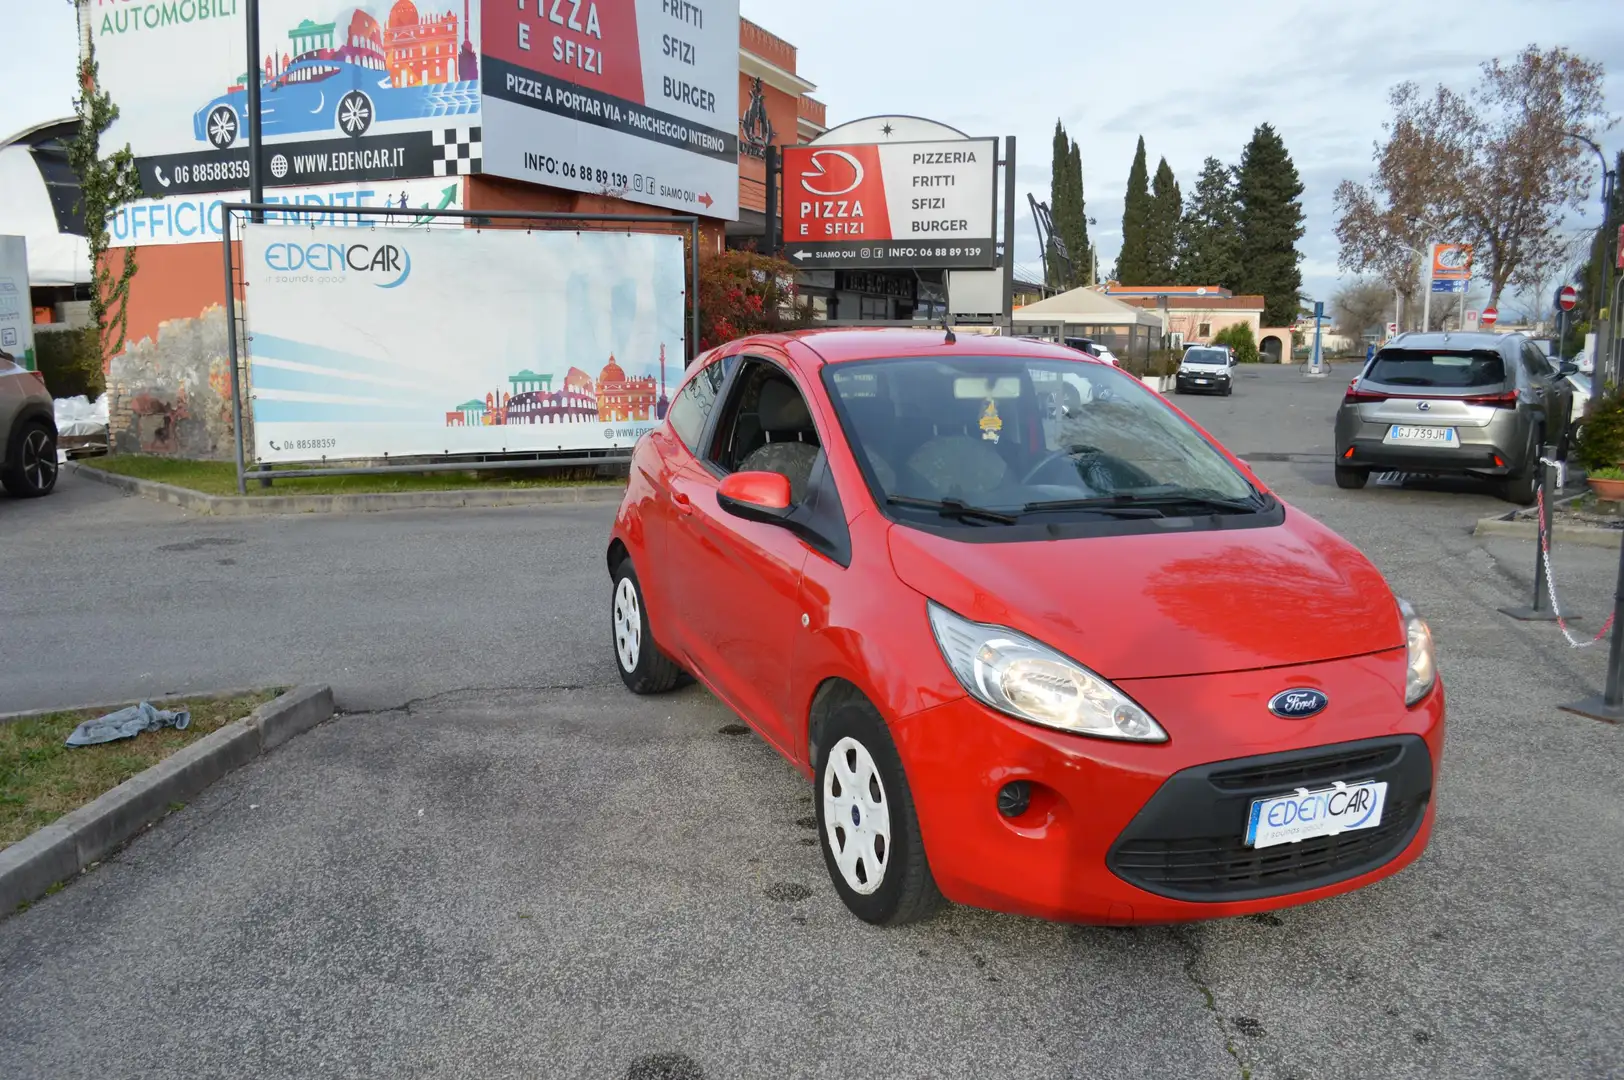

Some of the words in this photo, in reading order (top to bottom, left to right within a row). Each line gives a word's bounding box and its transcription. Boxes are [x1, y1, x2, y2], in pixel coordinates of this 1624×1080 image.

[518, 22, 531, 50] E
[552, 35, 602, 75] SFIZI
[663, 34, 695, 66] SFIZI
[663, 75, 715, 113] BURGER
[506, 74, 542, 100] PIZZE
[544, 86, 554, 103] A
[556, 88, 601, 116] PORTAR
[603, 102, 621, 123] VIA
[628, 111, 687, 142] PARCHEGGIO
[688, 127, 725, 153] INTERNO
[293, 147, 405, 174] WWW.EDENCAR.IT
[912, 152, 977, 165] PIZZERIA
[174, 166, 189, 184] 06
[192, 160, 250, 182] 88588359
[524, 152, 559, 175] INFO:
[562, 161, 576, 178] 06
[580, 165, 592, 182] 88
[596, 169, 608, 184] 89
[612, 172, 628, 188] 139
[912, 175, 955, 187] FRITTI
[660, 185, 683, 201] SIAMO
[684, 191, 696, 203] QUI
[911, 198, 945, 210] SFIZI
[800, 200, 865, 218] PIZZA
[800, 223, 809, 235] E
[825, 222, 865, 235] SFIZI
[911, 219, 968, 232] BURGER
[264, 243, 401, 271] EDENCAR
[815, 251, 840, 259] SIAMO
[842, 251, 856, 259] QUI
[889, 248, 917, 257] INFO:
[920, 248, 932, 257] 06
[935, 248, 947, 257] 88
[949, 247, 961, 257] 89
[965, 247, 981, 256] 139
[284, 440, 294, 450] 06
[296, 438, 336, 449] 88588359
[1284, 692, 1317, 713] Ford
[1267, 787, 1369, 827] EDENCAR
